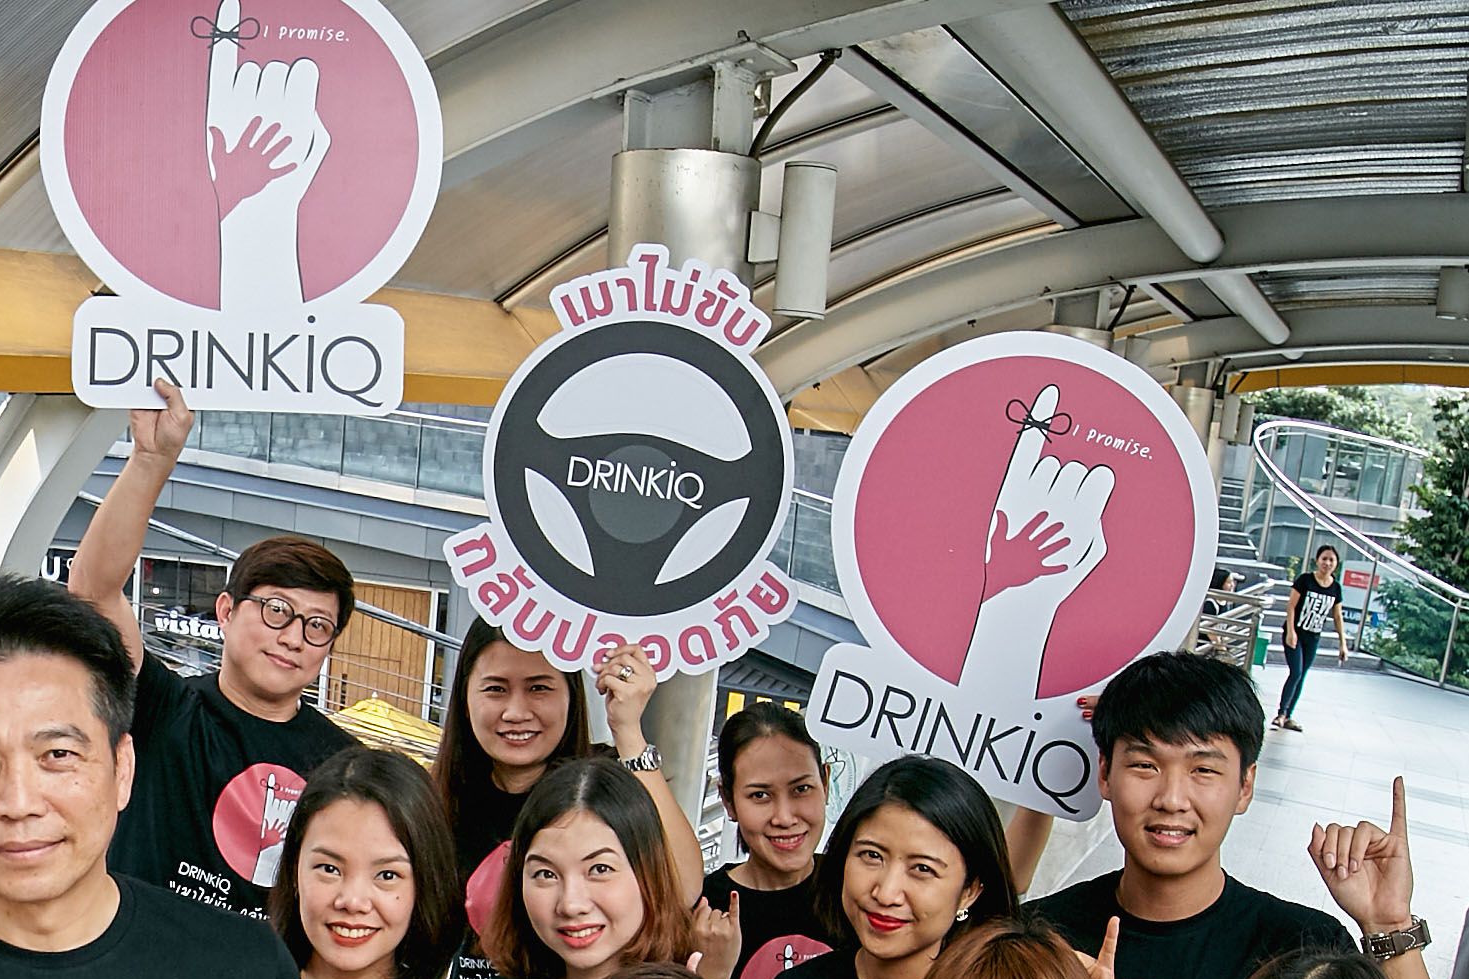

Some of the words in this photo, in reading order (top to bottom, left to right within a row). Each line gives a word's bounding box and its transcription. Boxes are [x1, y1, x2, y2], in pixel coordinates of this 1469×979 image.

[278, 26, 349, 42] Promise.
[560, 253, 761, 347] เมาไม่ขับ
[1086, 427, 1154, 461] Promise.
